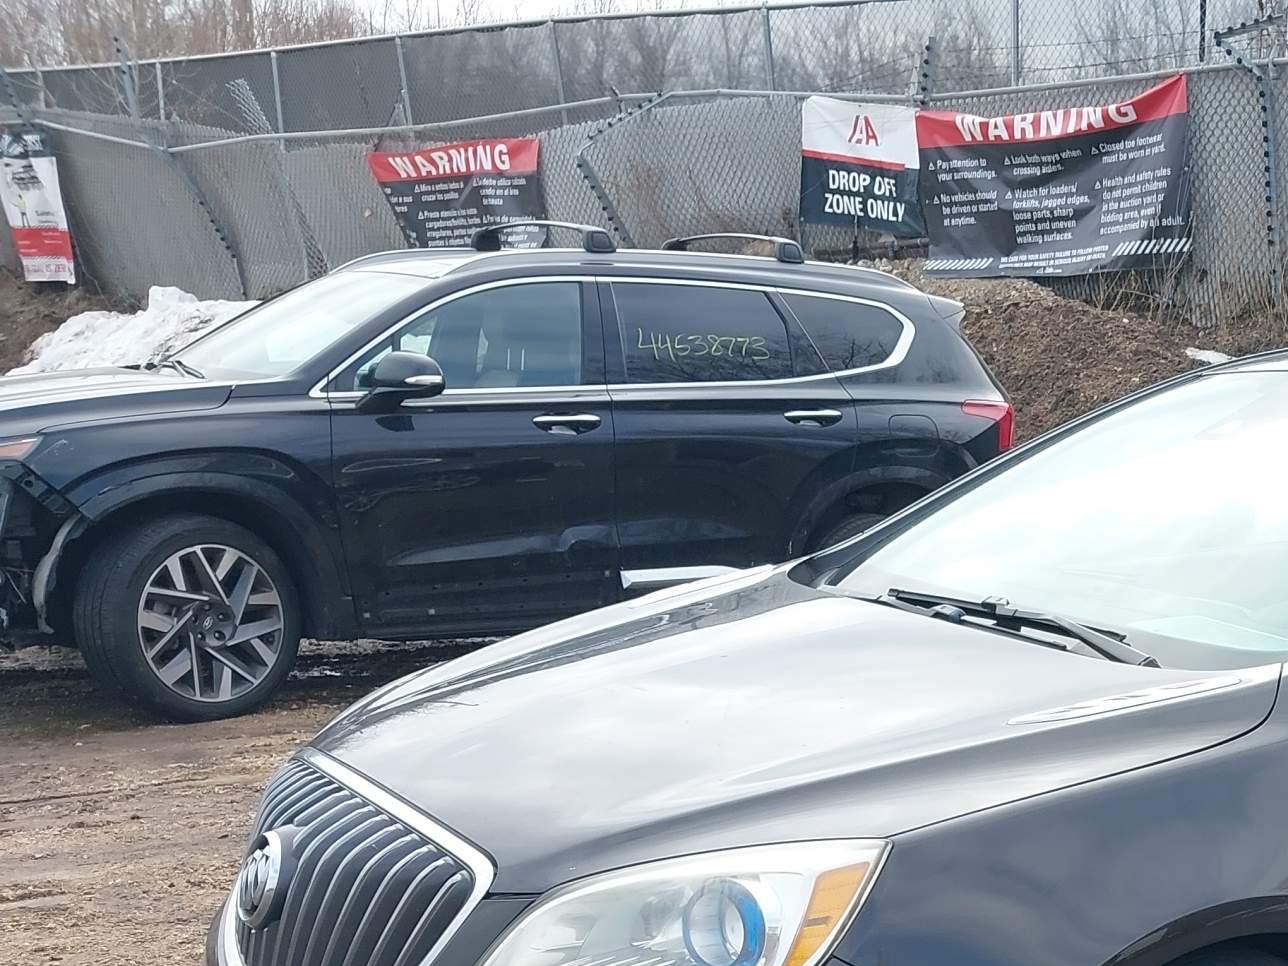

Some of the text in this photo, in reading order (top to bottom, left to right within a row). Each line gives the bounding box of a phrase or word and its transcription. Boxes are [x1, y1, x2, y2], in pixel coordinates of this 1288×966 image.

[955, 103, 1137, 142] WARNING
[1099, 140, 1124, 152] Closed
[388, 144, 511, 178] WARNING
[1102, 153, 1118, 164] must
[1119, 152, 1127, 161] be
[1128, 149, 1144, 160] worn
[937, 160, 949, 171] Pay
[980, 158, 987, 167] to
[1013, 166, 1040, 176] crossing
[829, 169, 897, 197] DROP OFF
[937, 173, 953, 183] your
[1102, 176, 1123, 188] Health
[1124, 173, 1135, 184] and
[1155, 166, 1171, 177] rules
[1015, 188, 1037, 199] Watch
[1039, 187, 1048, 196] for
[1102, 189, 1111, 200] do
[1142, 180, 1167, 192] children
[940, 193, 950, 202] No
[1120, 196, 1142, 208] auction
[824, 193, 905, 222] ZONE ONLY
[942, 205, 950, 215] be
[952, 204, 970, 214] driven
[1013, 208, 1074, 222] loose parts, sharp
[1140, 219, 1148, 229] by
[1162, 215, 1185, 226] adult.
[1015, 220, 1077, 234] points and uneven
[1016, 234, 1042, 244] walking
[638, 327, 770, 362] 44538773
